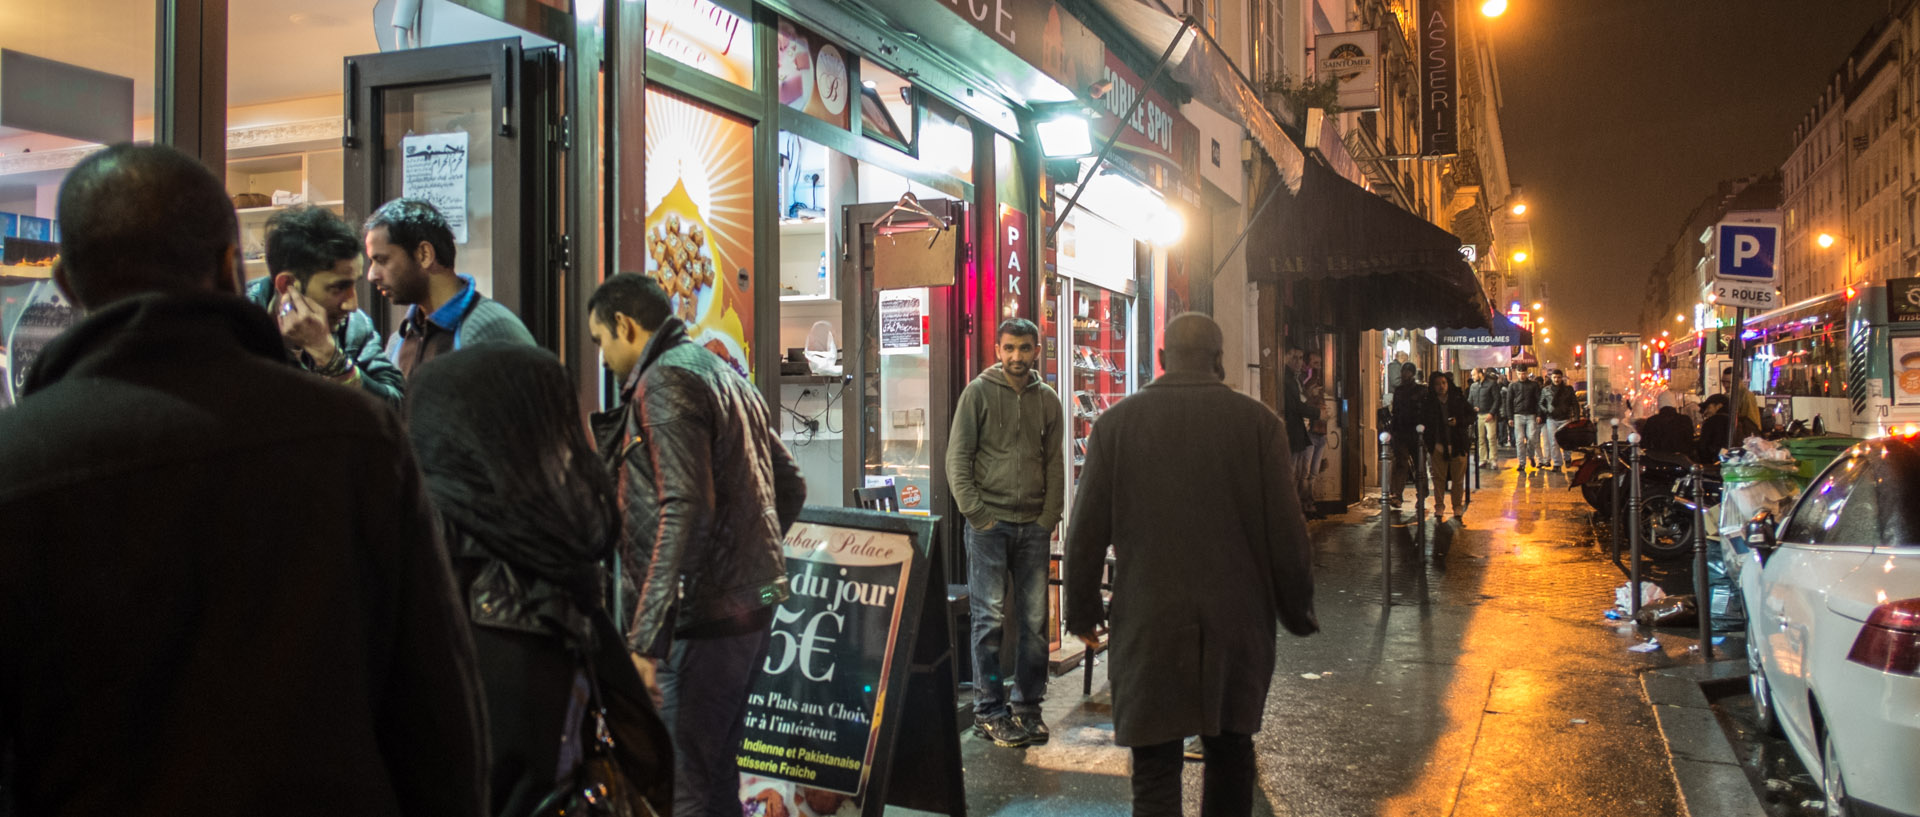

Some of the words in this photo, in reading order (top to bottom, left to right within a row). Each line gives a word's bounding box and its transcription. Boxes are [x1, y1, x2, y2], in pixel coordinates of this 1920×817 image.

[1147, 100, 1173, 154] SPOT
[1733, 234, 1760, 268] P
[1719, 287, 1726, 297] 2
[1731, 288, 1772, 303] ROUES
[1443, 335, 1467, 343] FRUITS
[1874, 404, 1889, 417] 70
[829, 529, 895, 560] Palace
[790, 562, 829, 598] du
[826, 567, 895, 611] jour
[762, 603, 845, 682] 5€
[767, 691, 799, 712] Plats
[800, 702, 824, 716] aux
[743, 738, 785, 757] Indienne
[786, 747, 797, 760] et
[797, 748, 862, 771] Pakistanaise
